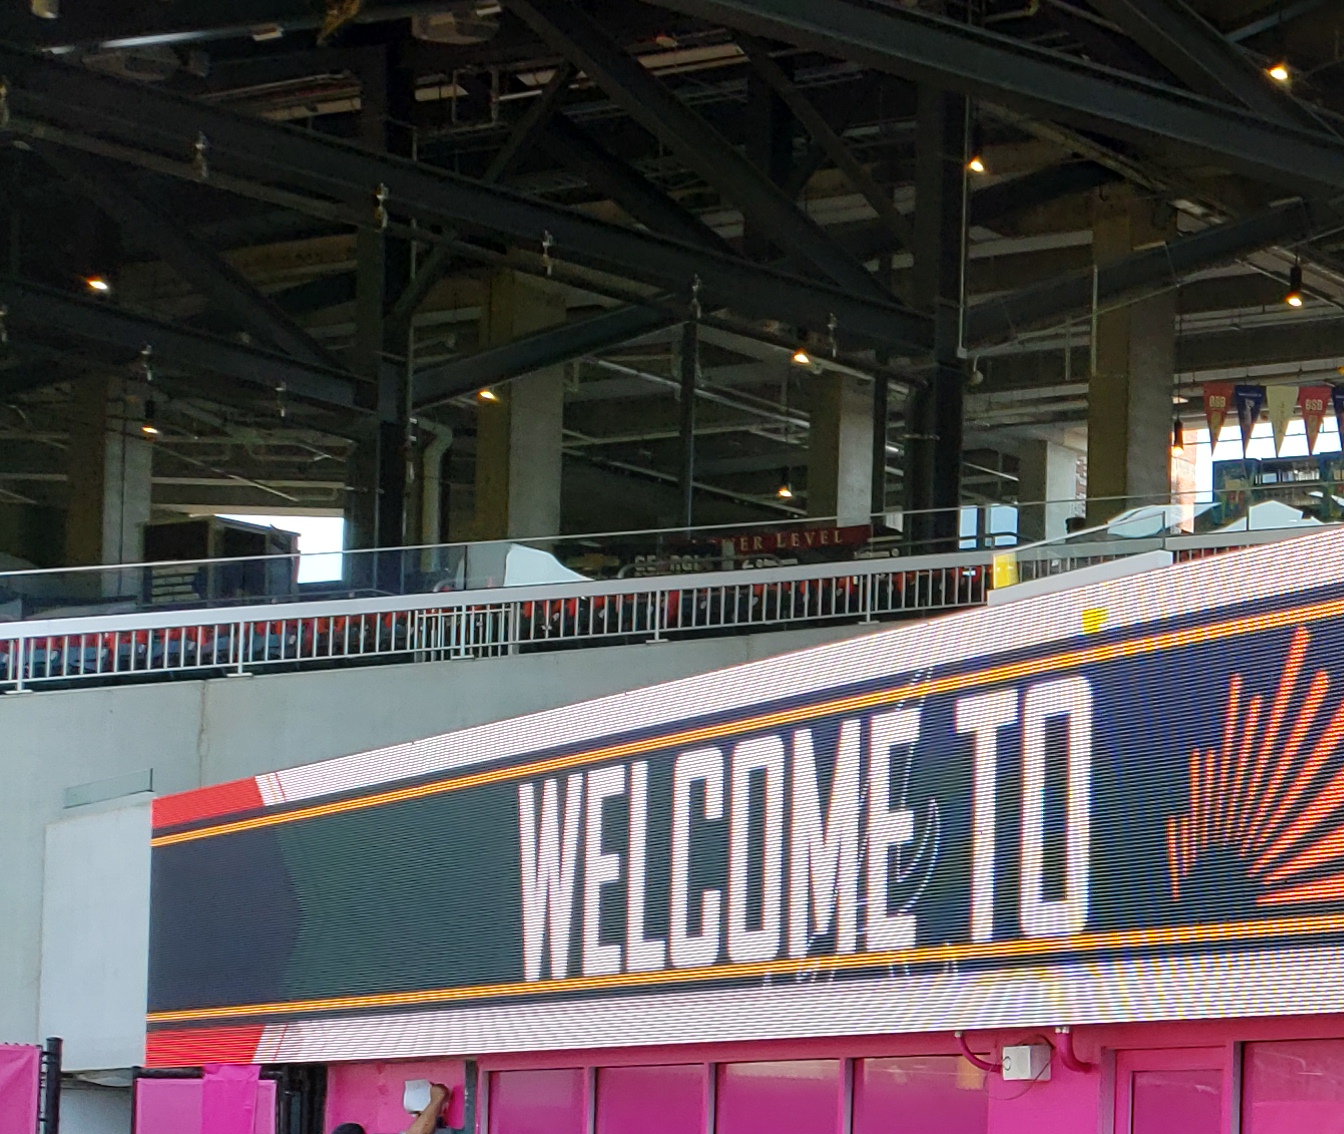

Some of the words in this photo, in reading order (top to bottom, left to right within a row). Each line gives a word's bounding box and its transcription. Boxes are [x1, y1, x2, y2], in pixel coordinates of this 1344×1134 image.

[776, 530, 844, 549] LEVEL
[518, 706, 921, 982] WELCOME
[954, 675, 1093, 943] TO
